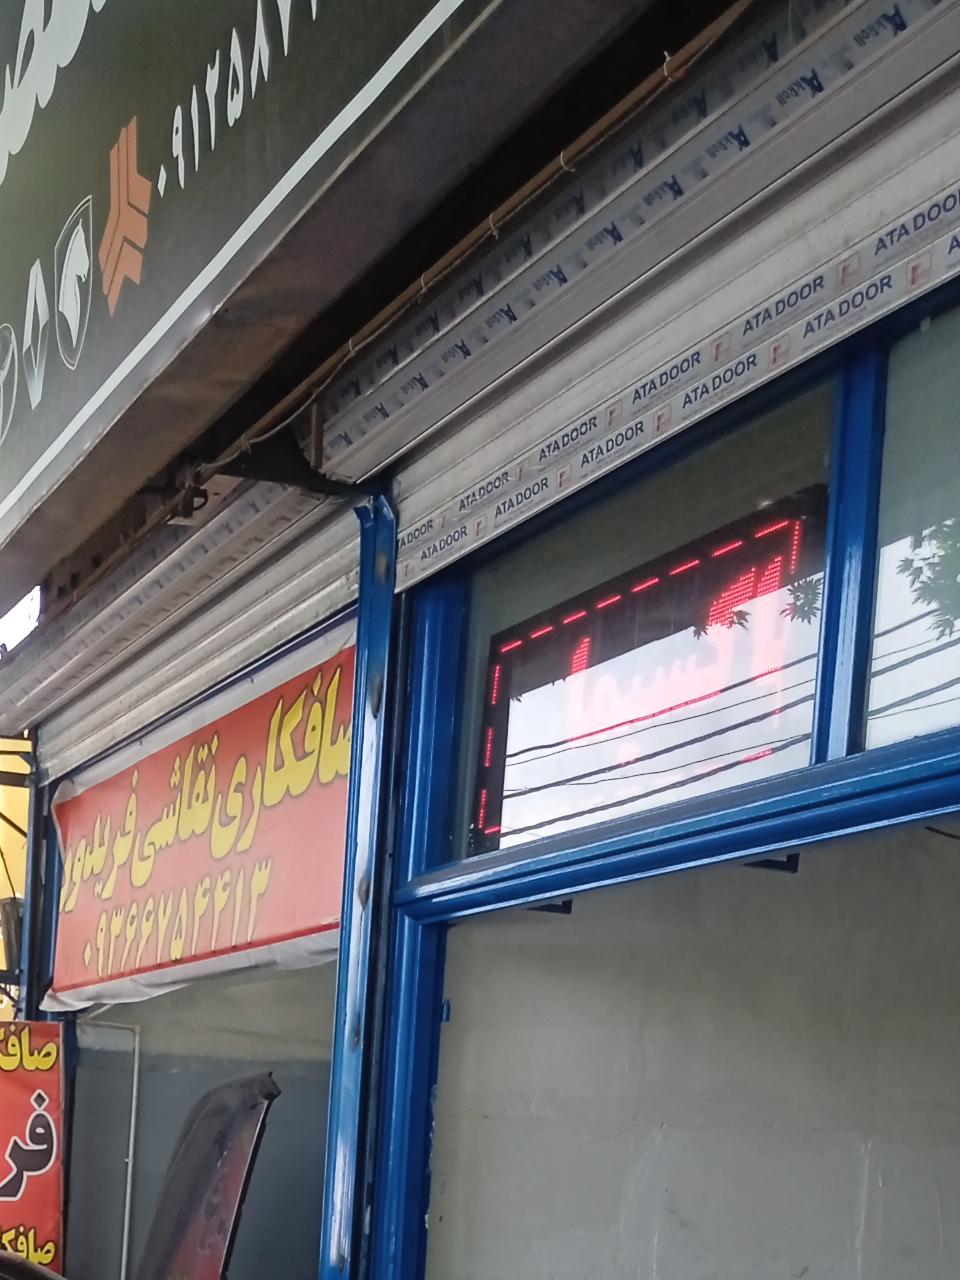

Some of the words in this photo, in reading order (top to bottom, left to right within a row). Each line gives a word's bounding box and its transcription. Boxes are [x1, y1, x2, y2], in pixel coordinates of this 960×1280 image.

[421, 543, 438, 561] ATA
[439, 525, 468, 552] DOOR
[495, 500, 515, 518] ATA
[516, 476, 549, 506] DOOR
[581, 445, 604, 468] ATA
[606, 420, 644, 454] DOOR
[682, 382, 710, 408] ATA
[712, 353, 757, 390] DOOR
[803, 308, 836, 338] ATA
[839, 274, 893, 317] DOOR
[458, 494, 476, 512] ATA
[478, 471, 510, 501] DOOR
[539, 440, 560, 462] ATA
[561, 416, 598, 448] DOOR
[632, 381, 658, 404] ATA
[659, 351, 701, 387] DOOR
[742, 309, 772, 336] ATA
[776, 275, 825, 318] DOOR
[874, 223, 910, 256] ATA
[913, 188, 960, 231] DOO
[130, 732, 220, 888] نقاشی
